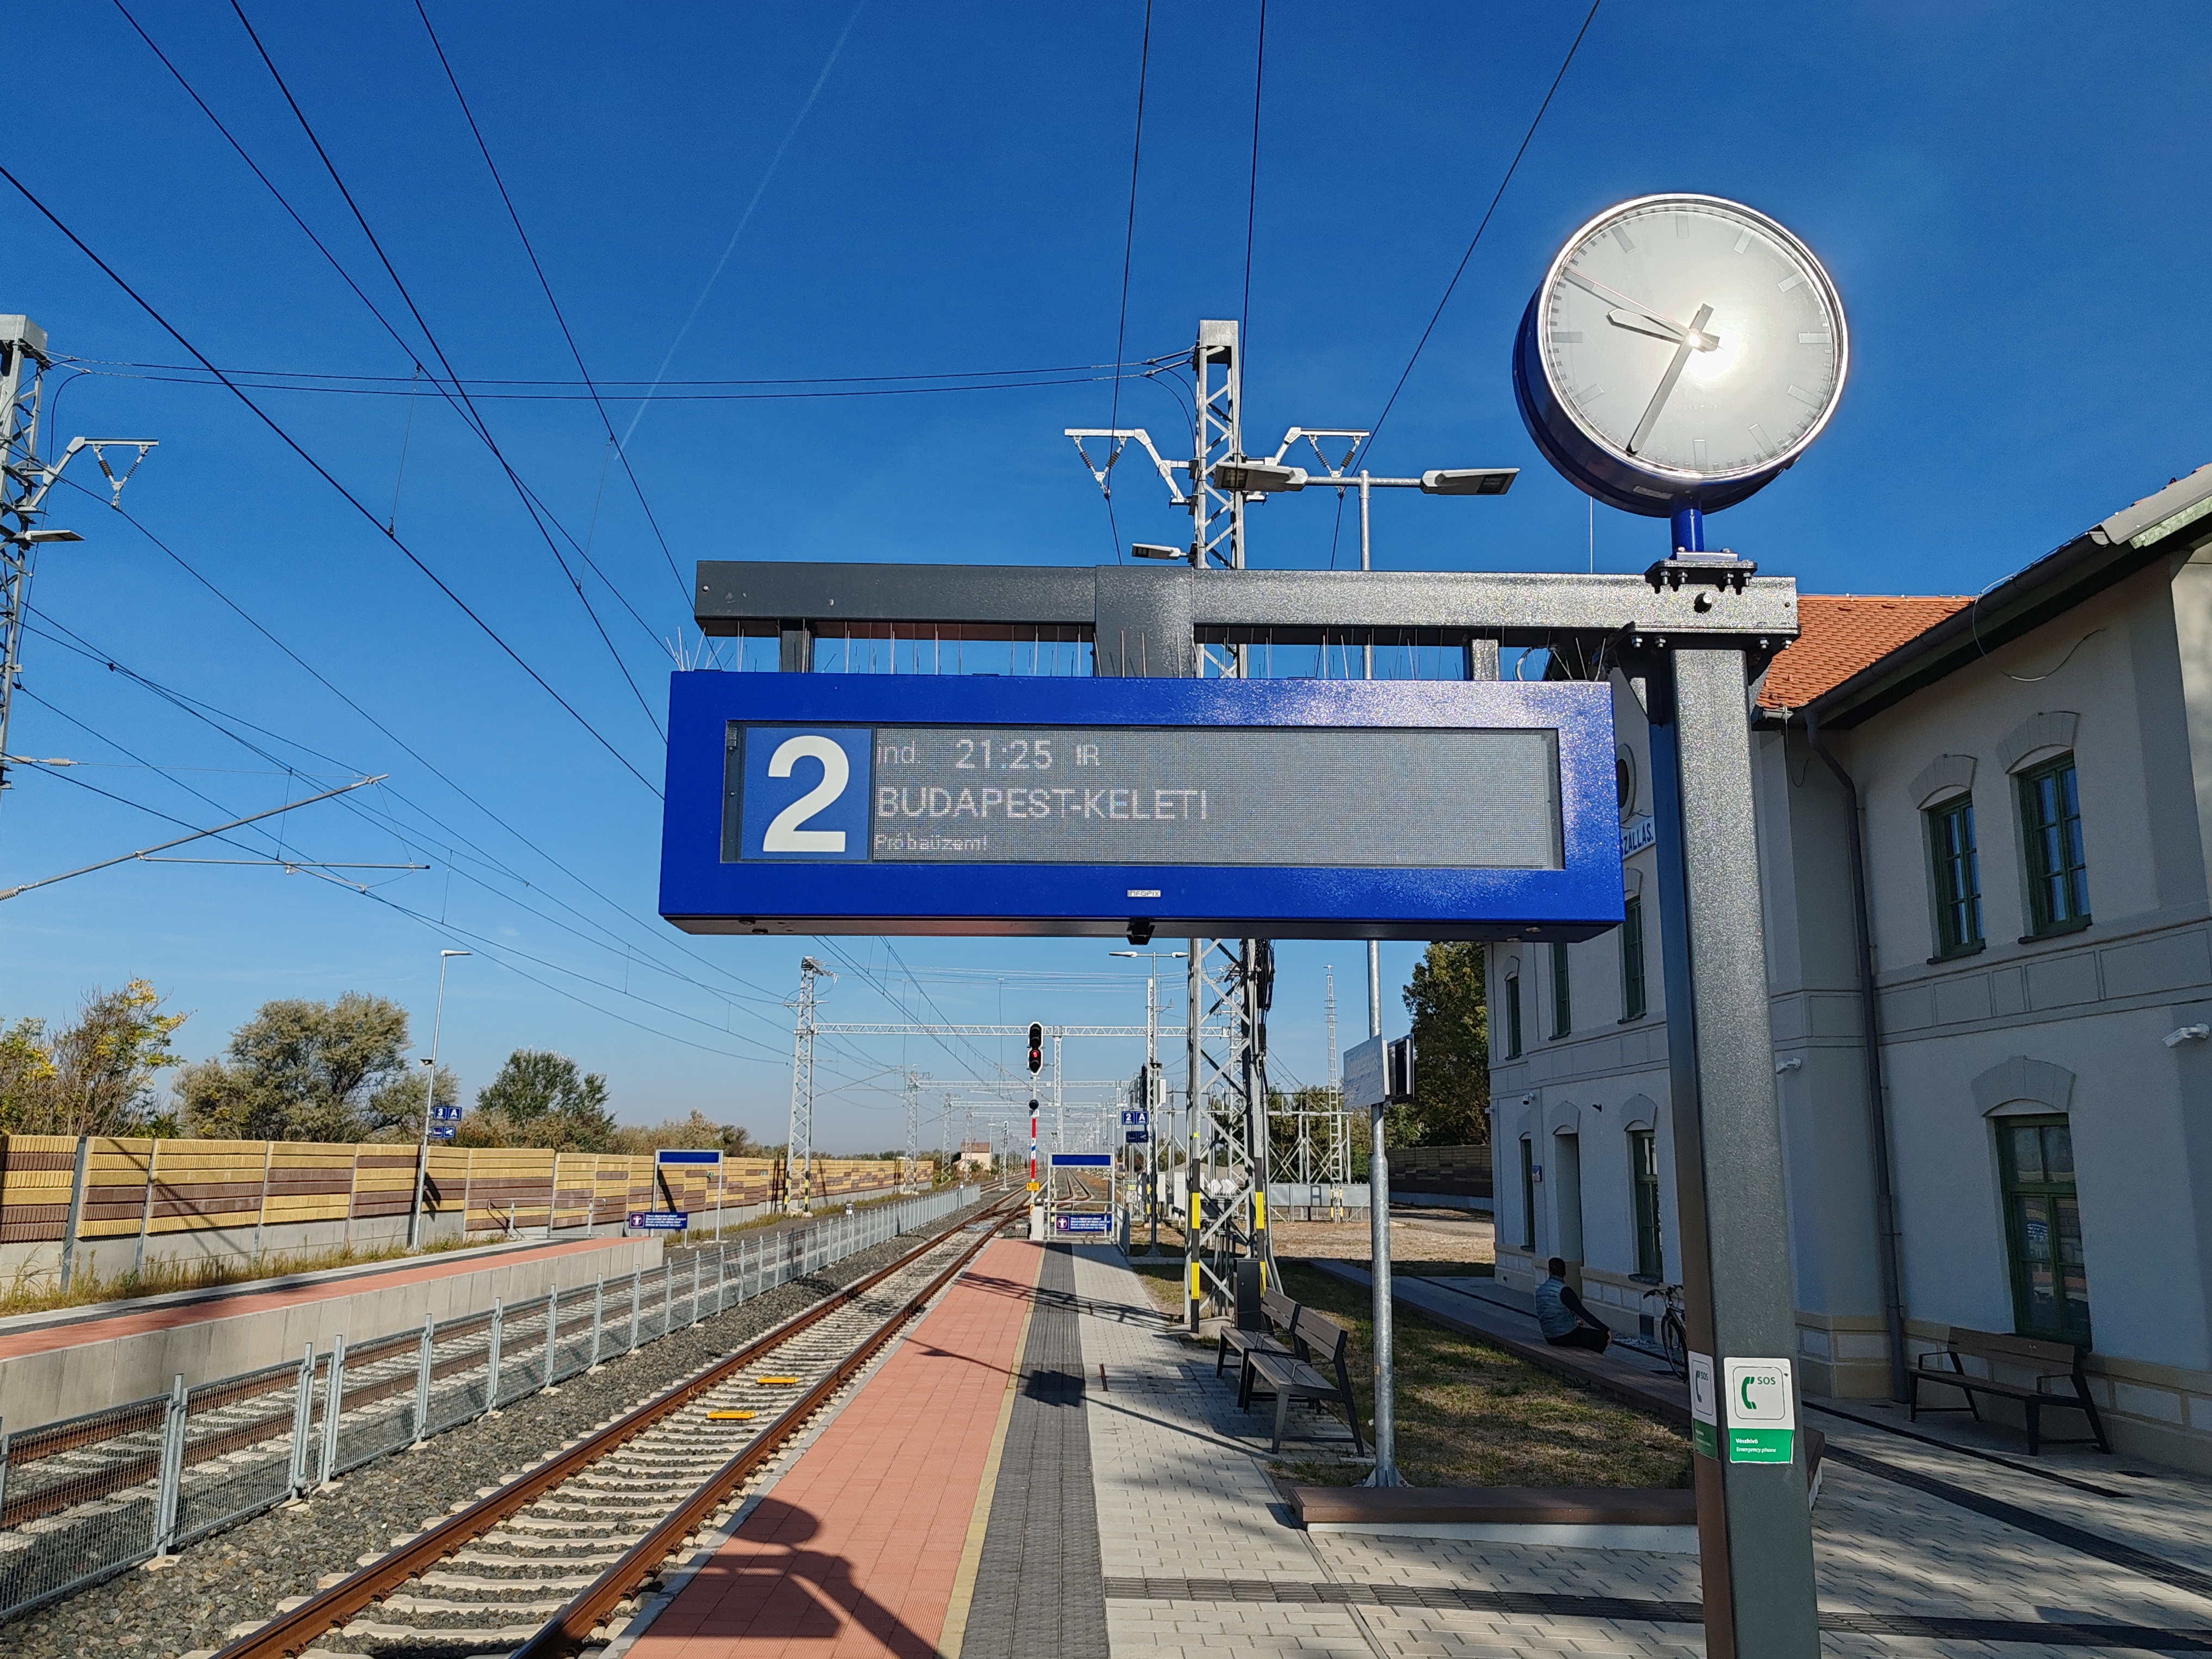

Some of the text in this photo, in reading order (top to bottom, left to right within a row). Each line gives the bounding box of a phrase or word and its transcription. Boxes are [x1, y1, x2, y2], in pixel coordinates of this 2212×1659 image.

[876, 739, 1100, 769] ind. 21:25 IR
[763, 735, 849, 852] 2
[877, 787, 1206, 819] BUDAPEST-KELETI
[438, 1108, 444, 1116] 3
[1700, 1371, 1709, 1381] SOS
[1757, 1377, 1776, 1385] SOS
